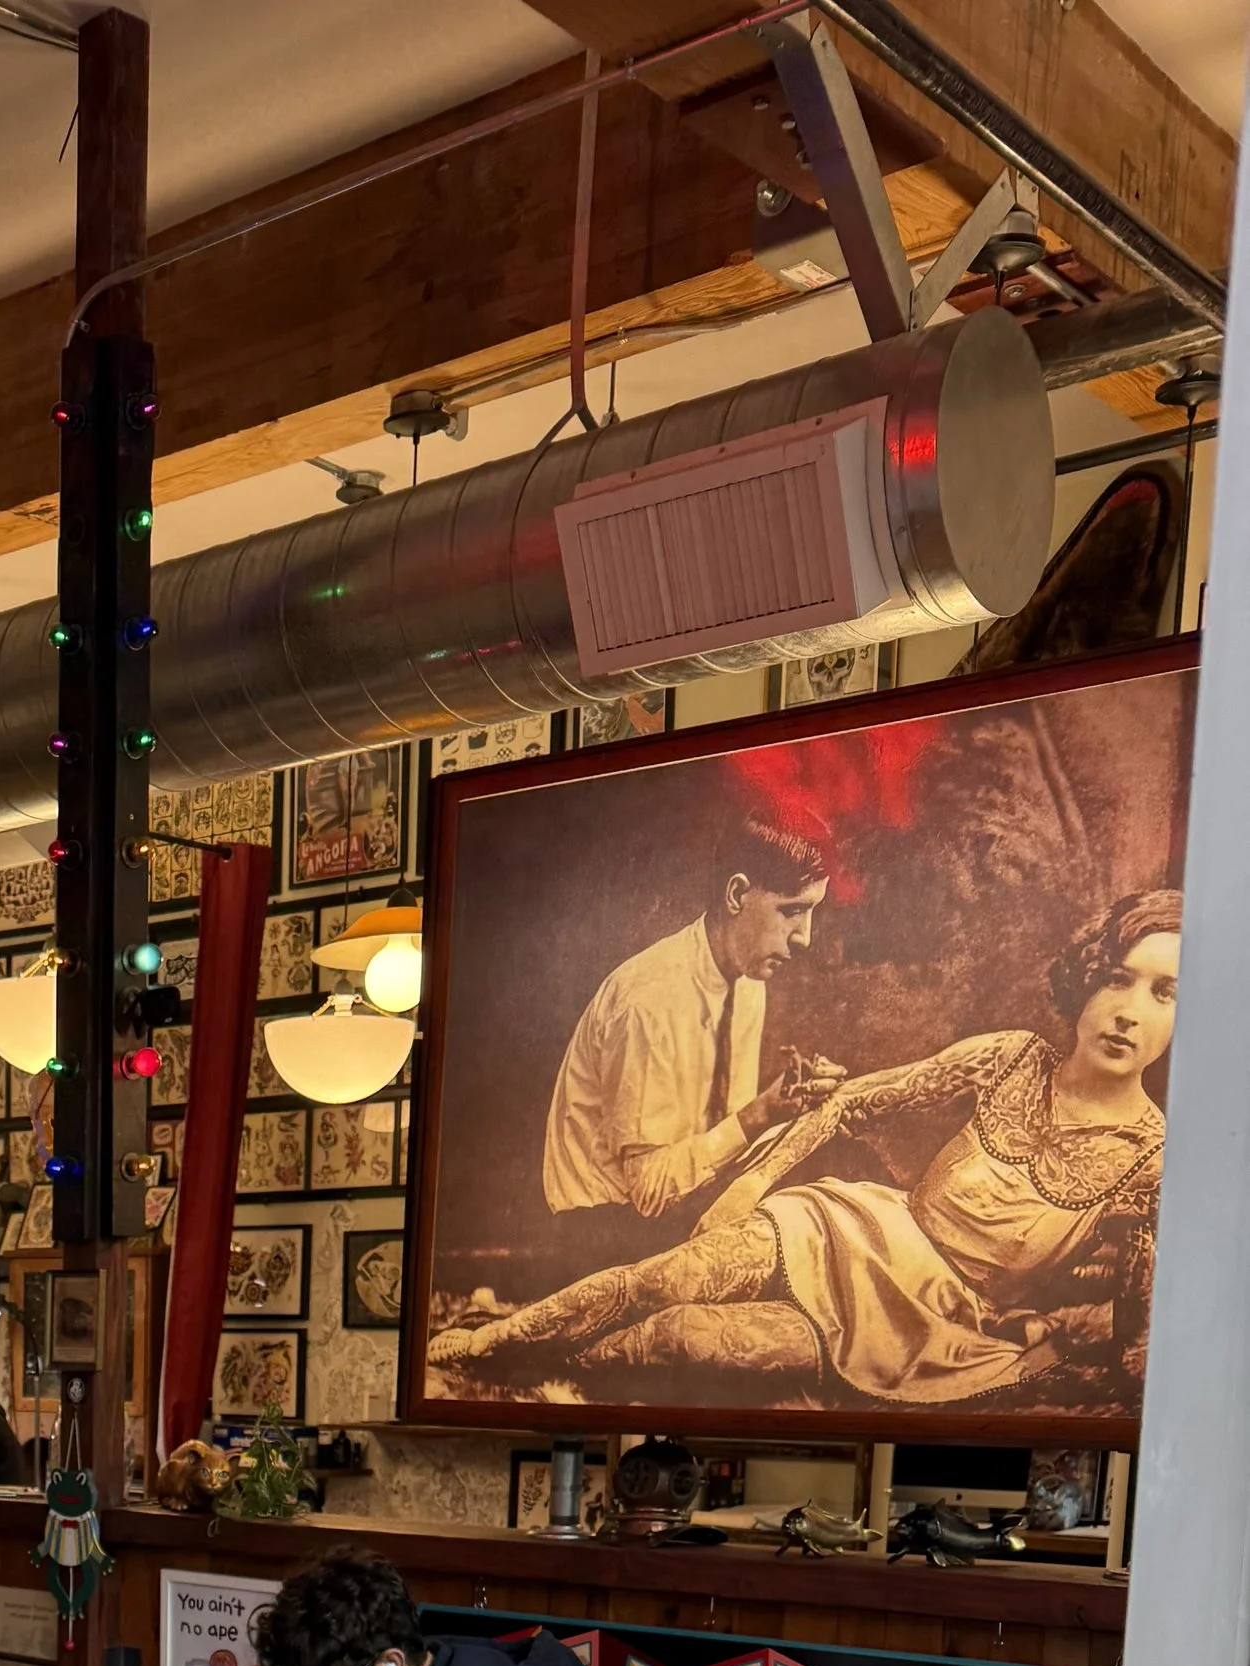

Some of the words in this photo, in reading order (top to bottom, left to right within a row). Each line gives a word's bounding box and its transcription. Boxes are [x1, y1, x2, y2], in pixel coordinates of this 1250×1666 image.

[177, 1592, 205, 1611] You
[208, 1594, 246, 1617] ain't
[180, 1621, 202, 1636] no
[207, 1624, 238, 1642] ape
